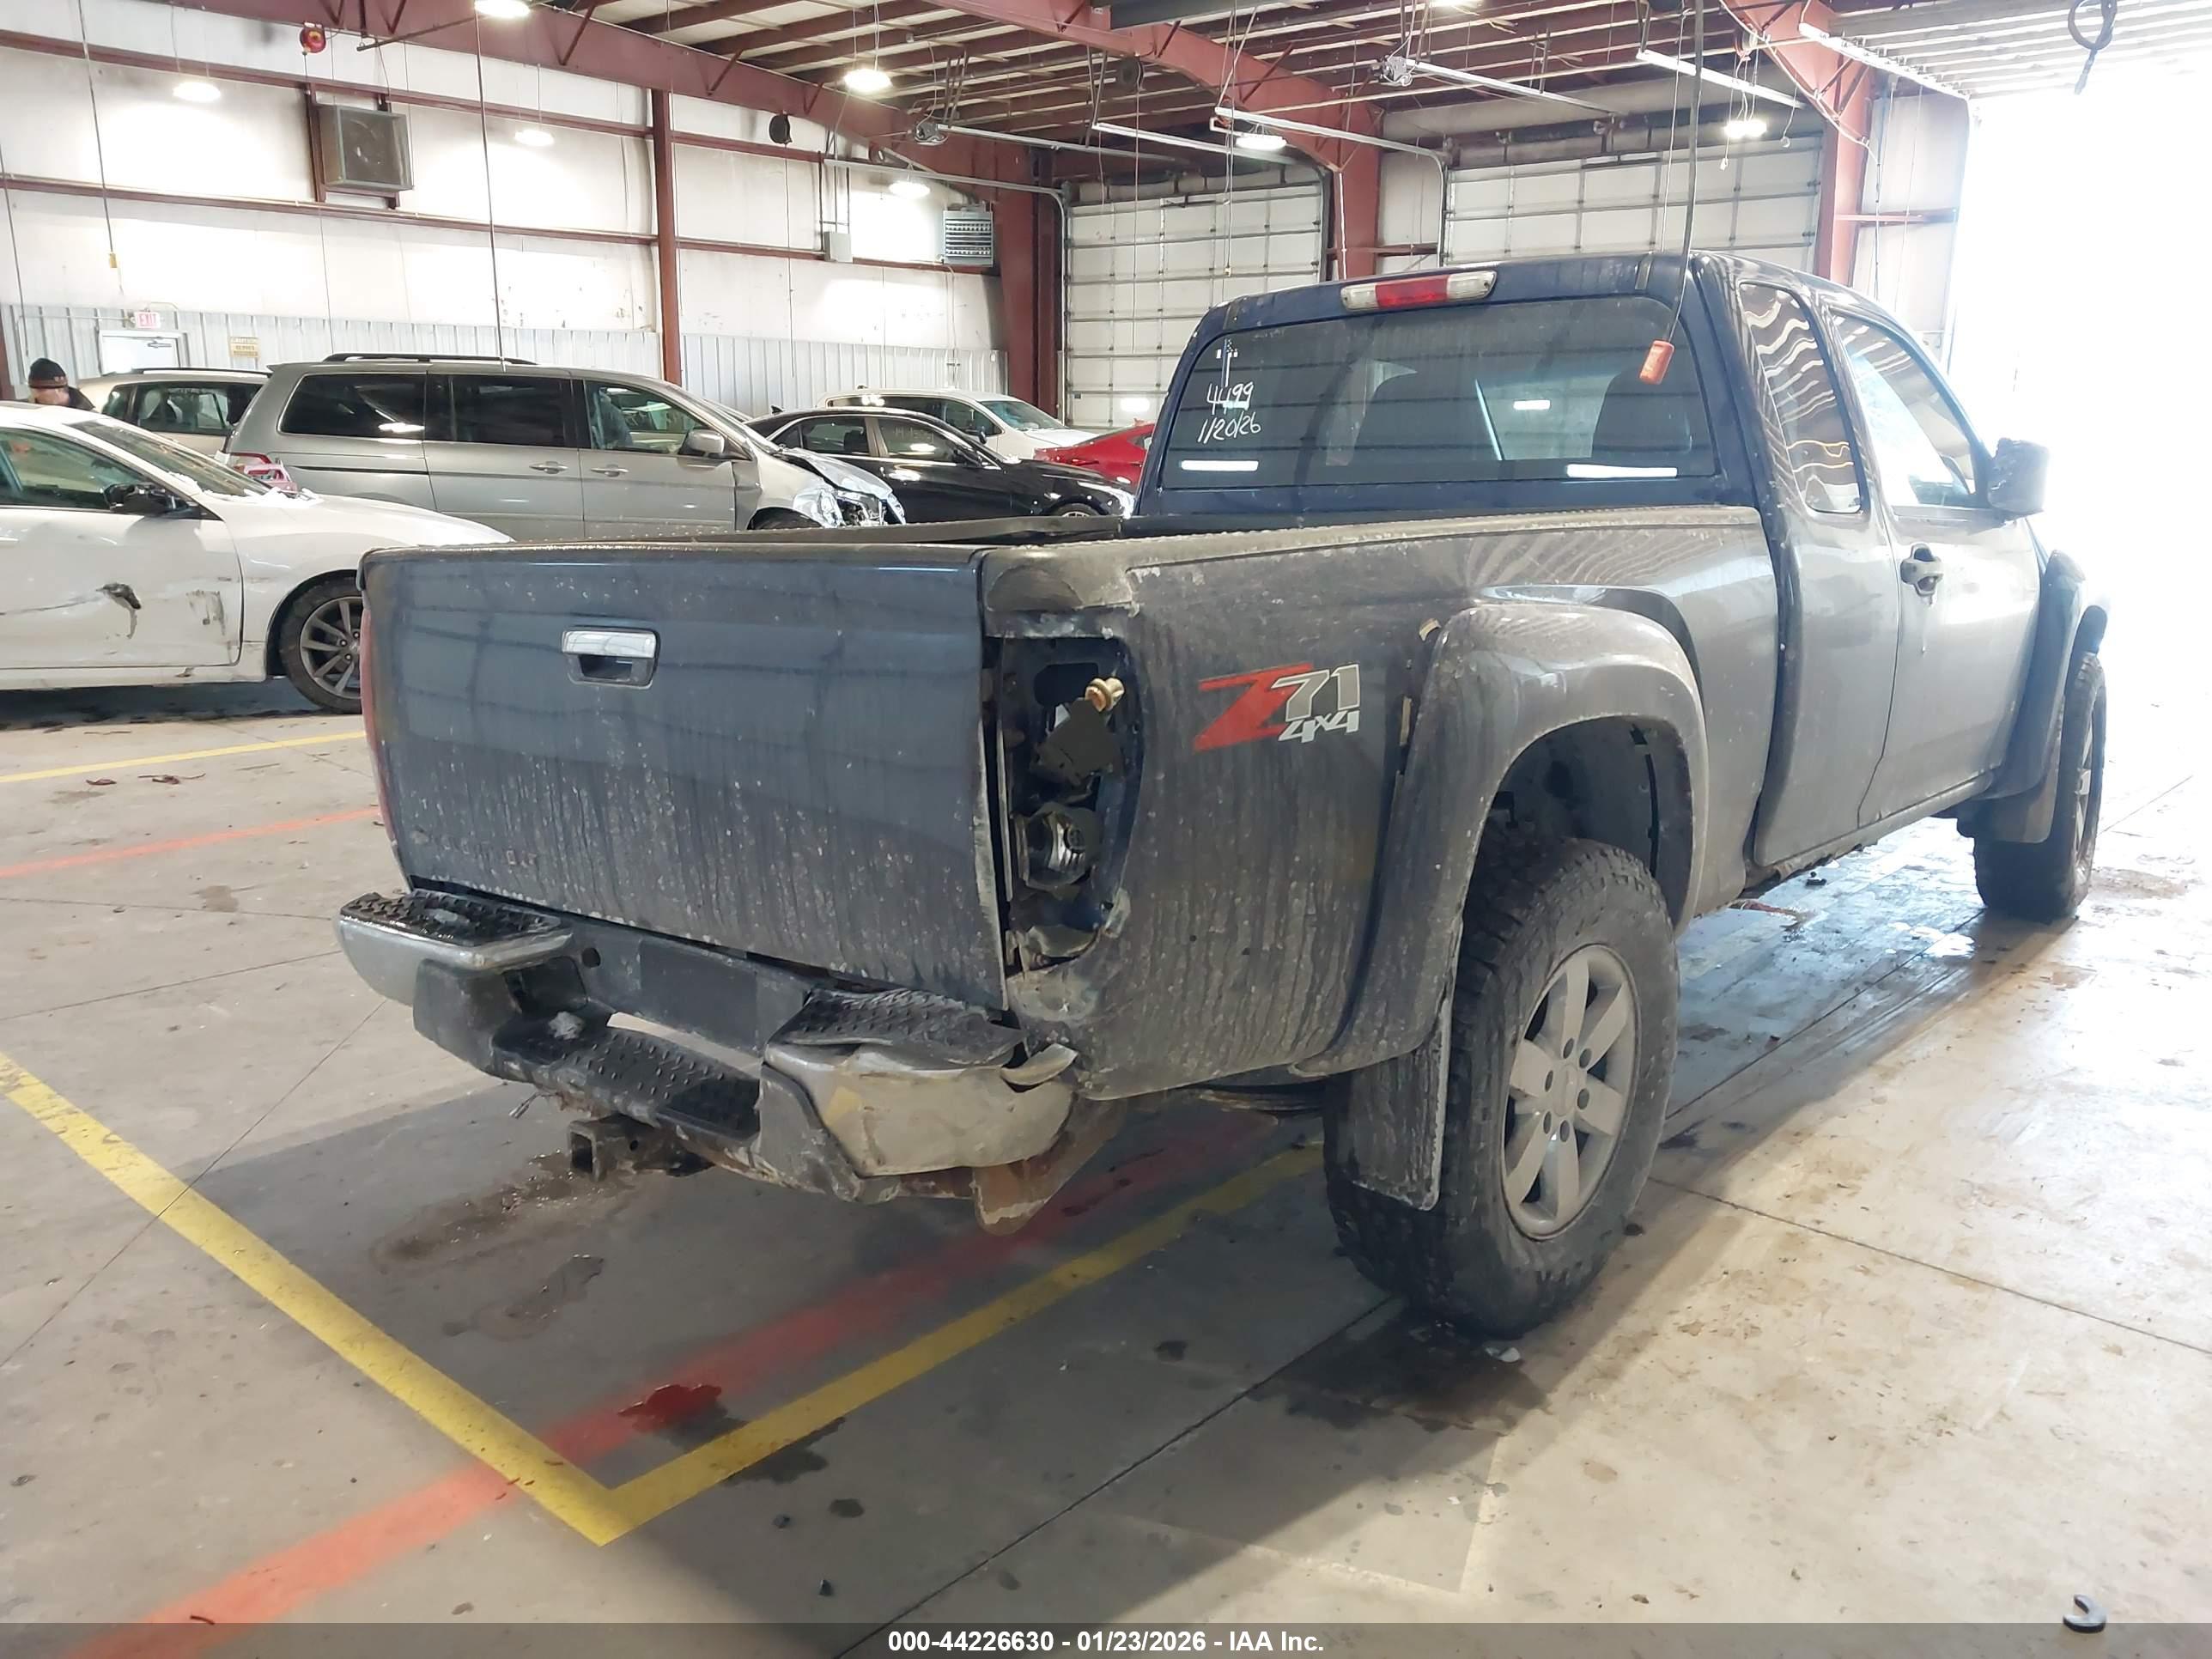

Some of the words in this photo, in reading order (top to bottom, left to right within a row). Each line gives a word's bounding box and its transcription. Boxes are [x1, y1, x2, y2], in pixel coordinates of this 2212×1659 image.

[138, 313, 156, 326] EXIT
[1206, 381, 1255, 416] 4499
[1197, 411, 1261, 444] 1/20/26
[1194, 662, 1361, 754] Z71
